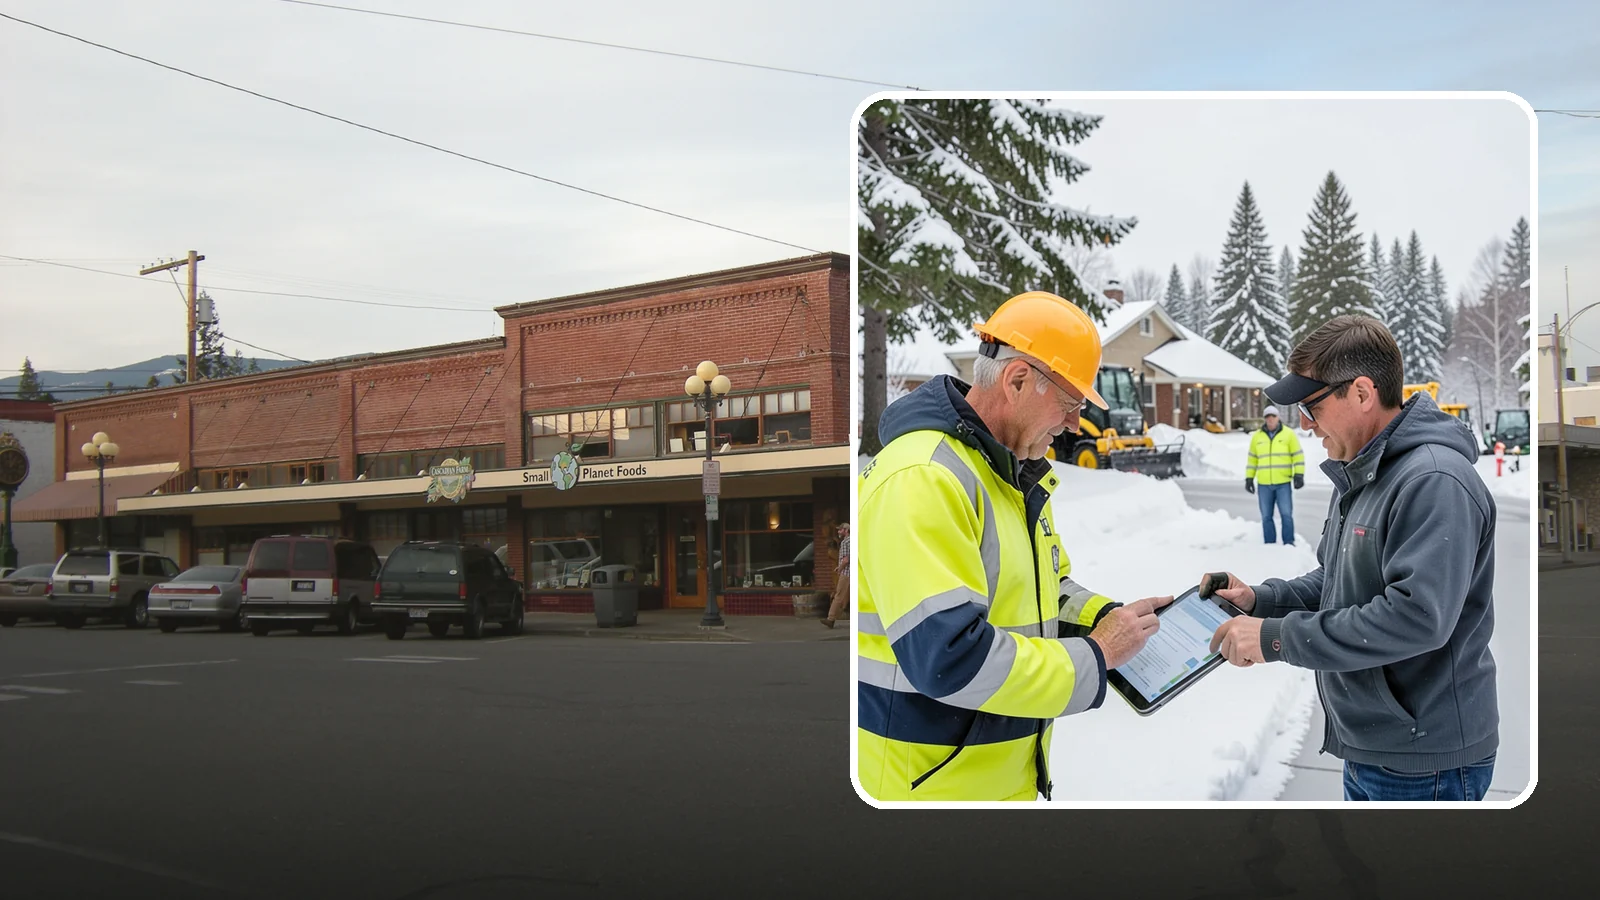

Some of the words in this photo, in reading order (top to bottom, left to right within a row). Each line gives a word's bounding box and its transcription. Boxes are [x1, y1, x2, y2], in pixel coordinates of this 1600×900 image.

[523, 470, 549, 483] Small
[582, 467, 614, 479] Planet
[617, 464, 647, 477] Foods
